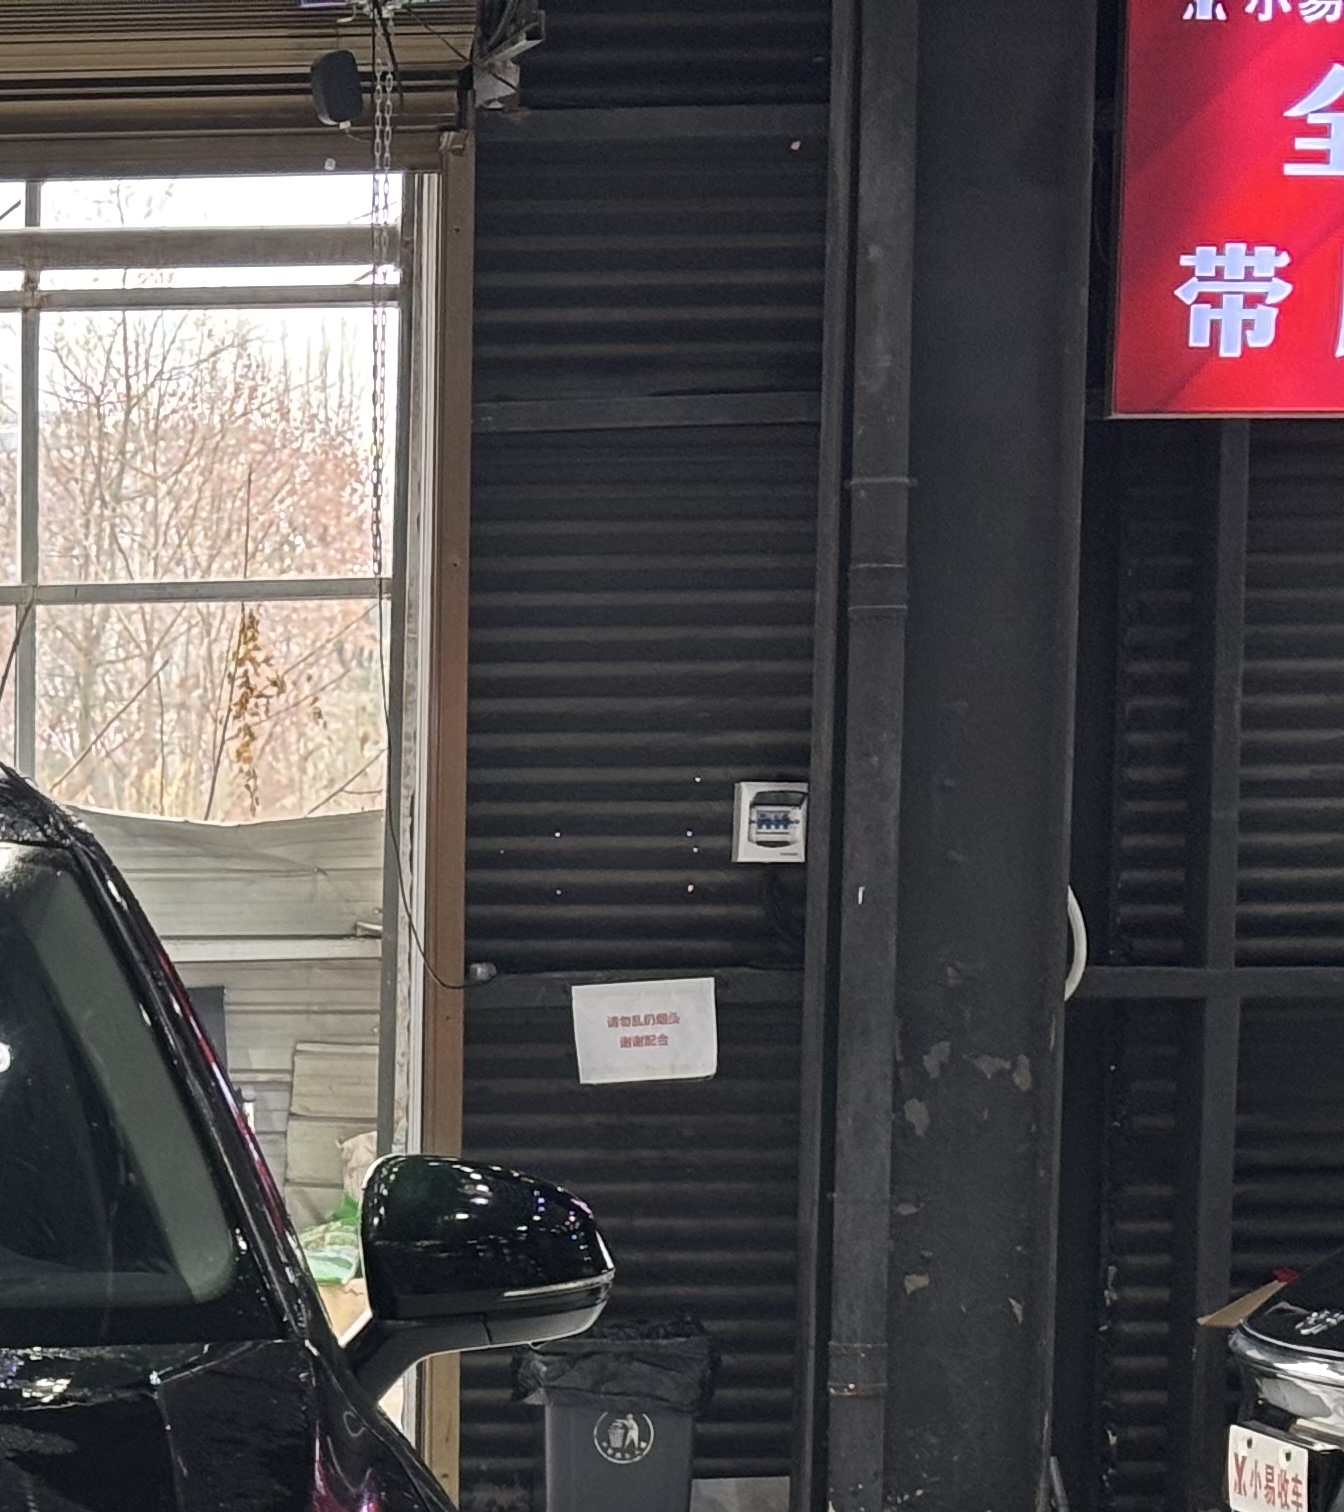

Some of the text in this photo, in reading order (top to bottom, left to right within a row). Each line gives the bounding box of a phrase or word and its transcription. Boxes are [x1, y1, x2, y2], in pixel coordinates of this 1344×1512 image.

[1174, 242, 1344, 358] 带
[620, 1033, 669, 1049] 谢谢配合
